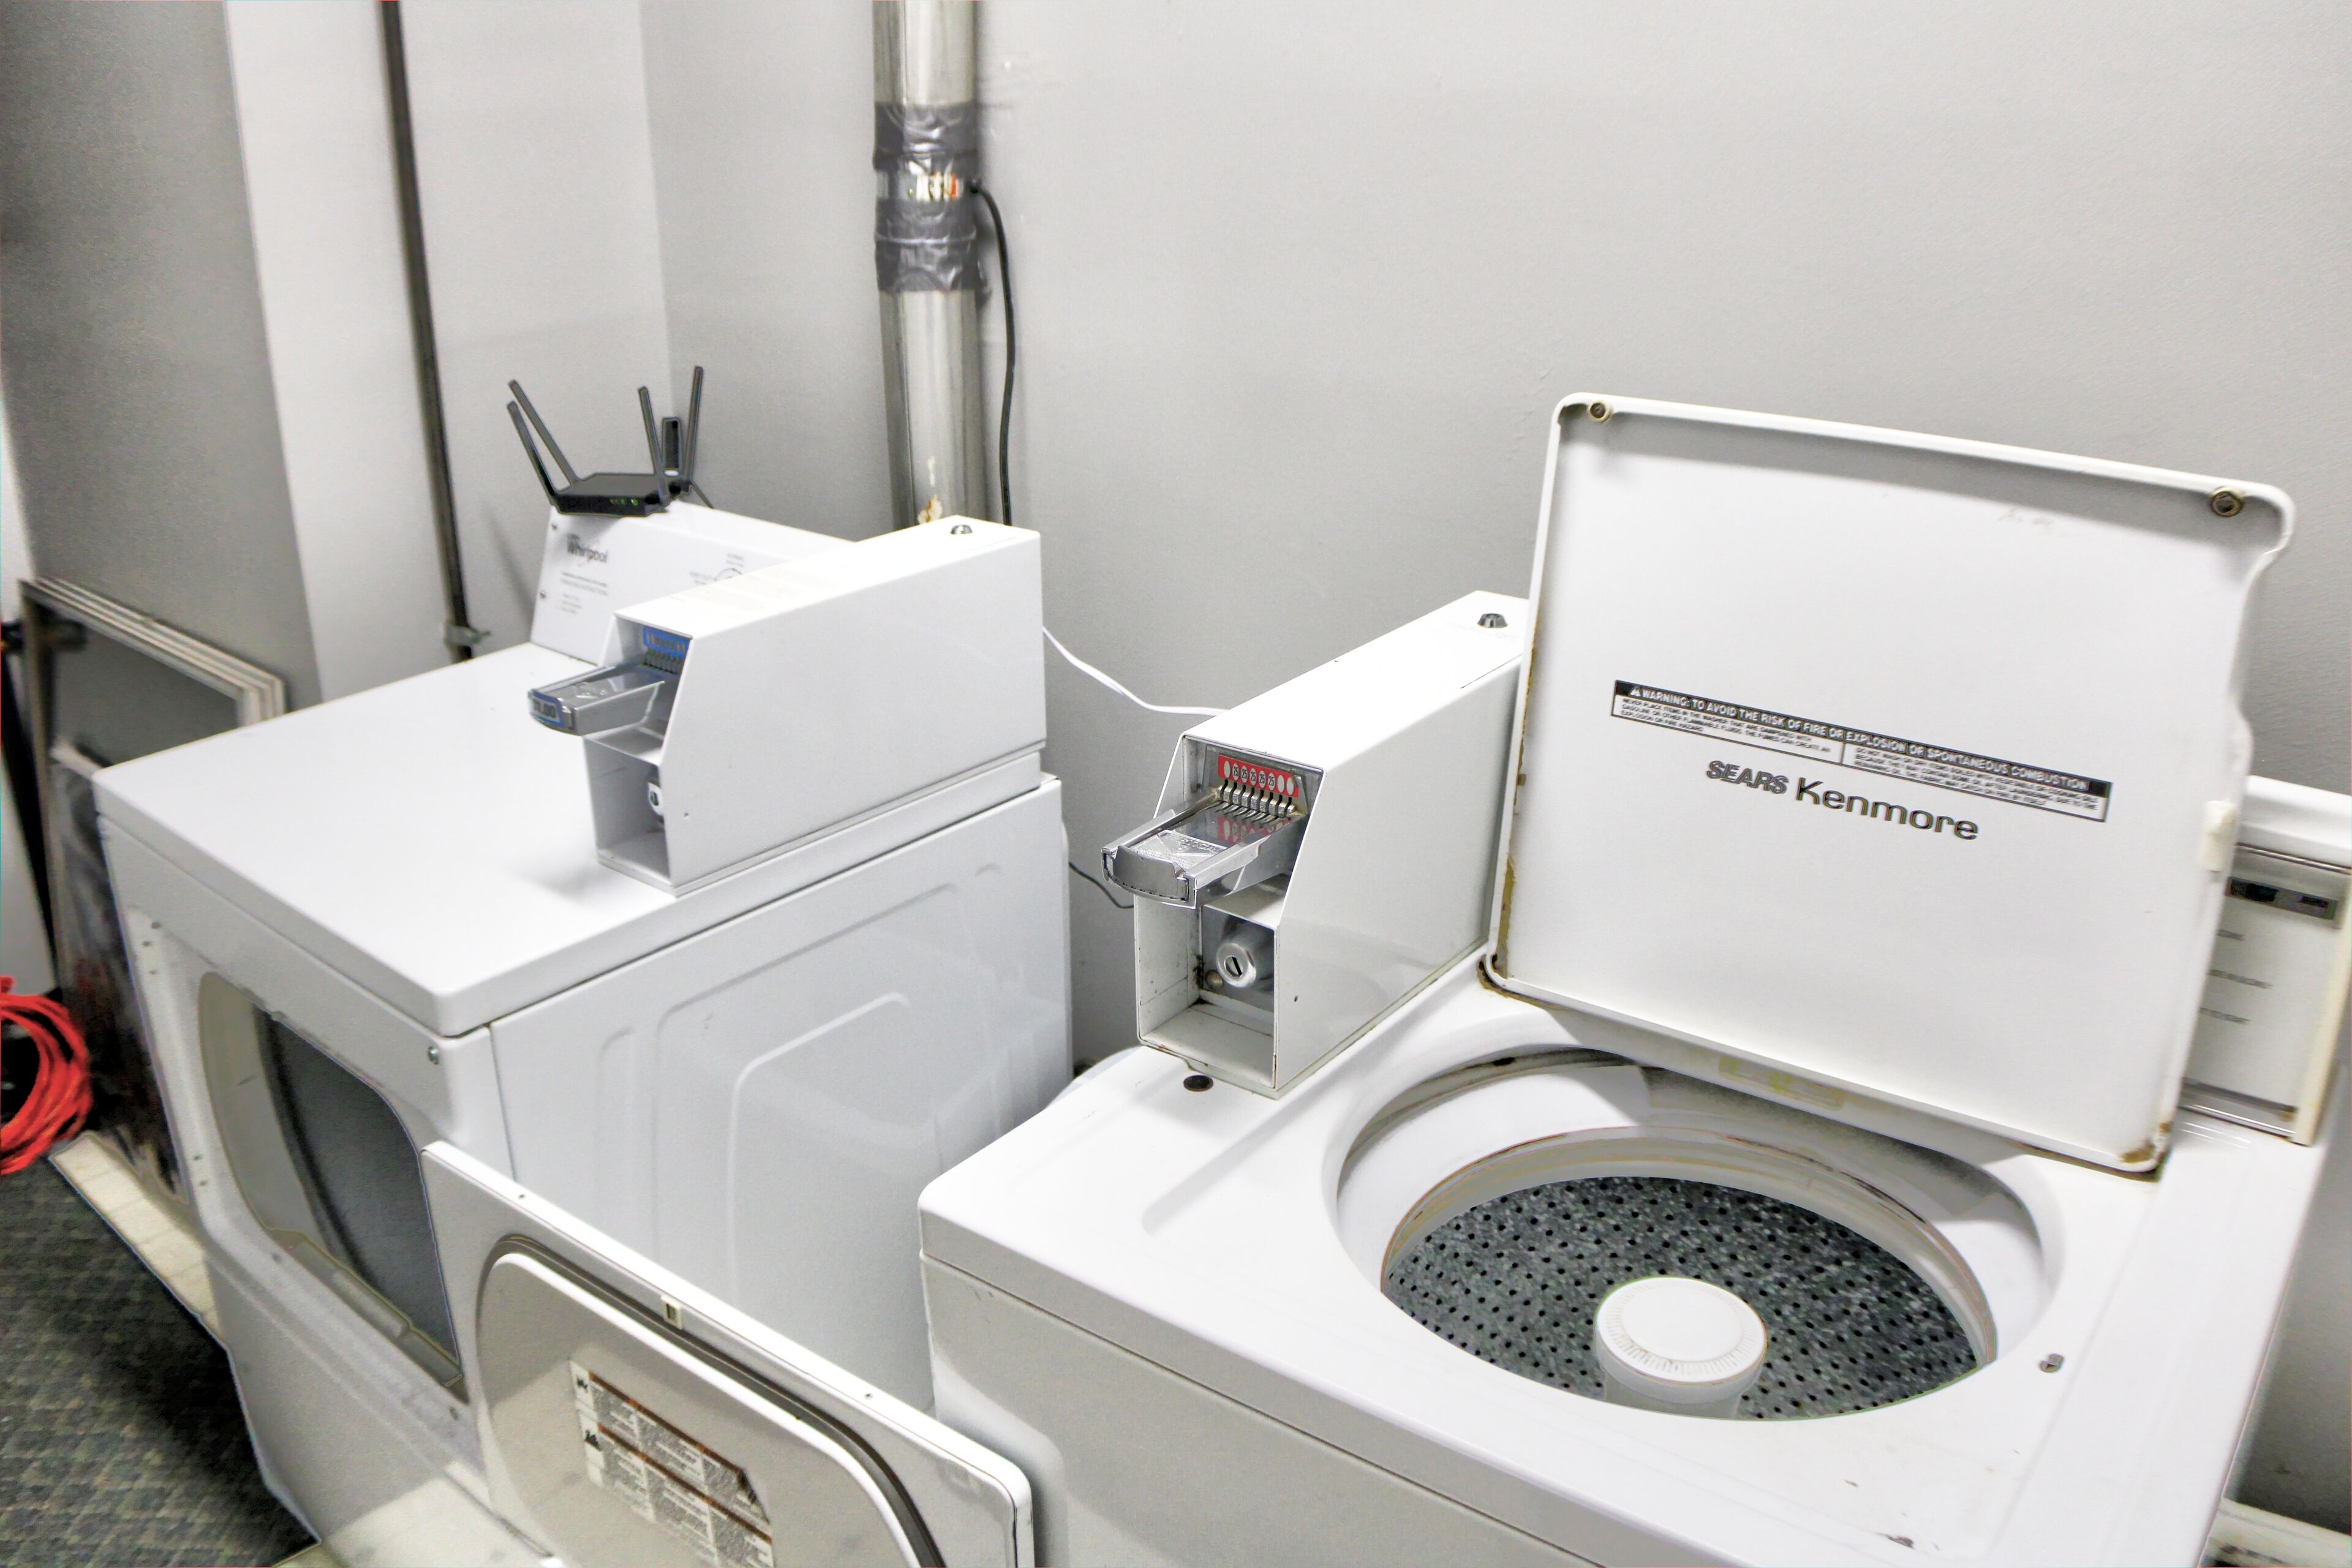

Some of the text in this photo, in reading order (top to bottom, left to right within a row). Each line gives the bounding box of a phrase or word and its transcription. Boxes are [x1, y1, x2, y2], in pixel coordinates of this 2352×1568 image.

[1233, 766, 1274, 786] 25 25 25 25 25
[1642, 688, 2087, 790] WARNING: TO AVOID THE RISK OF FIRE OR EXPLOSION OR SPONTANEOUS COMBUSTION
[1706, 760, 1978, 840] SEARS Kenmore
